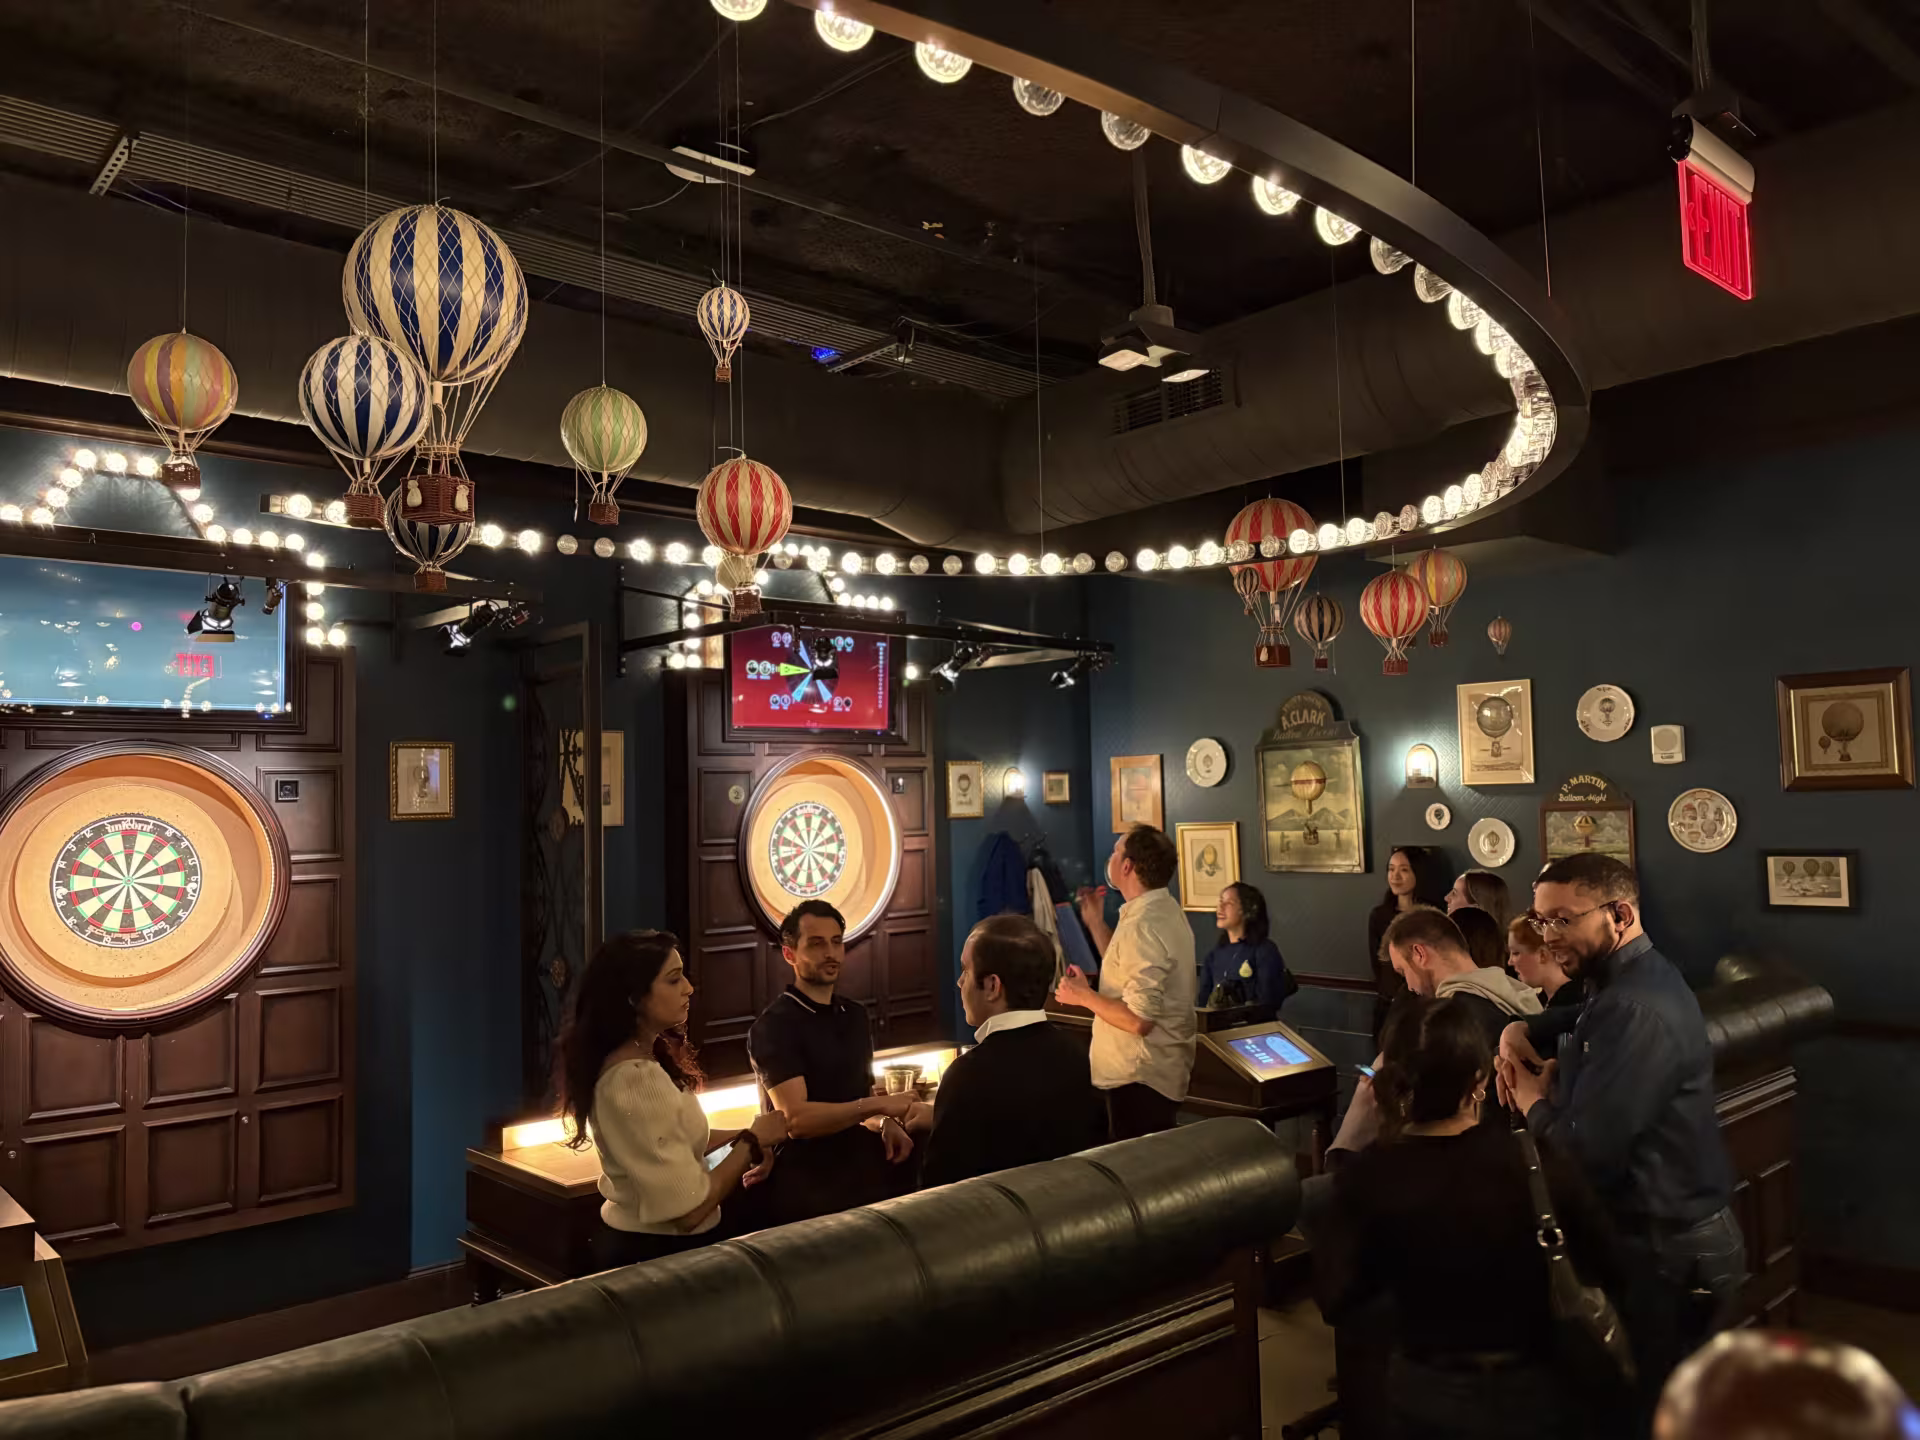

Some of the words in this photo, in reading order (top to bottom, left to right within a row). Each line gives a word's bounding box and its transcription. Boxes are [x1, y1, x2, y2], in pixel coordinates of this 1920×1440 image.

[1693, 173, 1742, 290] EXIT
[1569, 774, 1607, 791] MARTIN
[1559, 793, 1585, 802] Balloon
[165, 827, 174, 837] 18
[180, 841, 188, 849] 4
[142, 920, 166, 935] PRO
